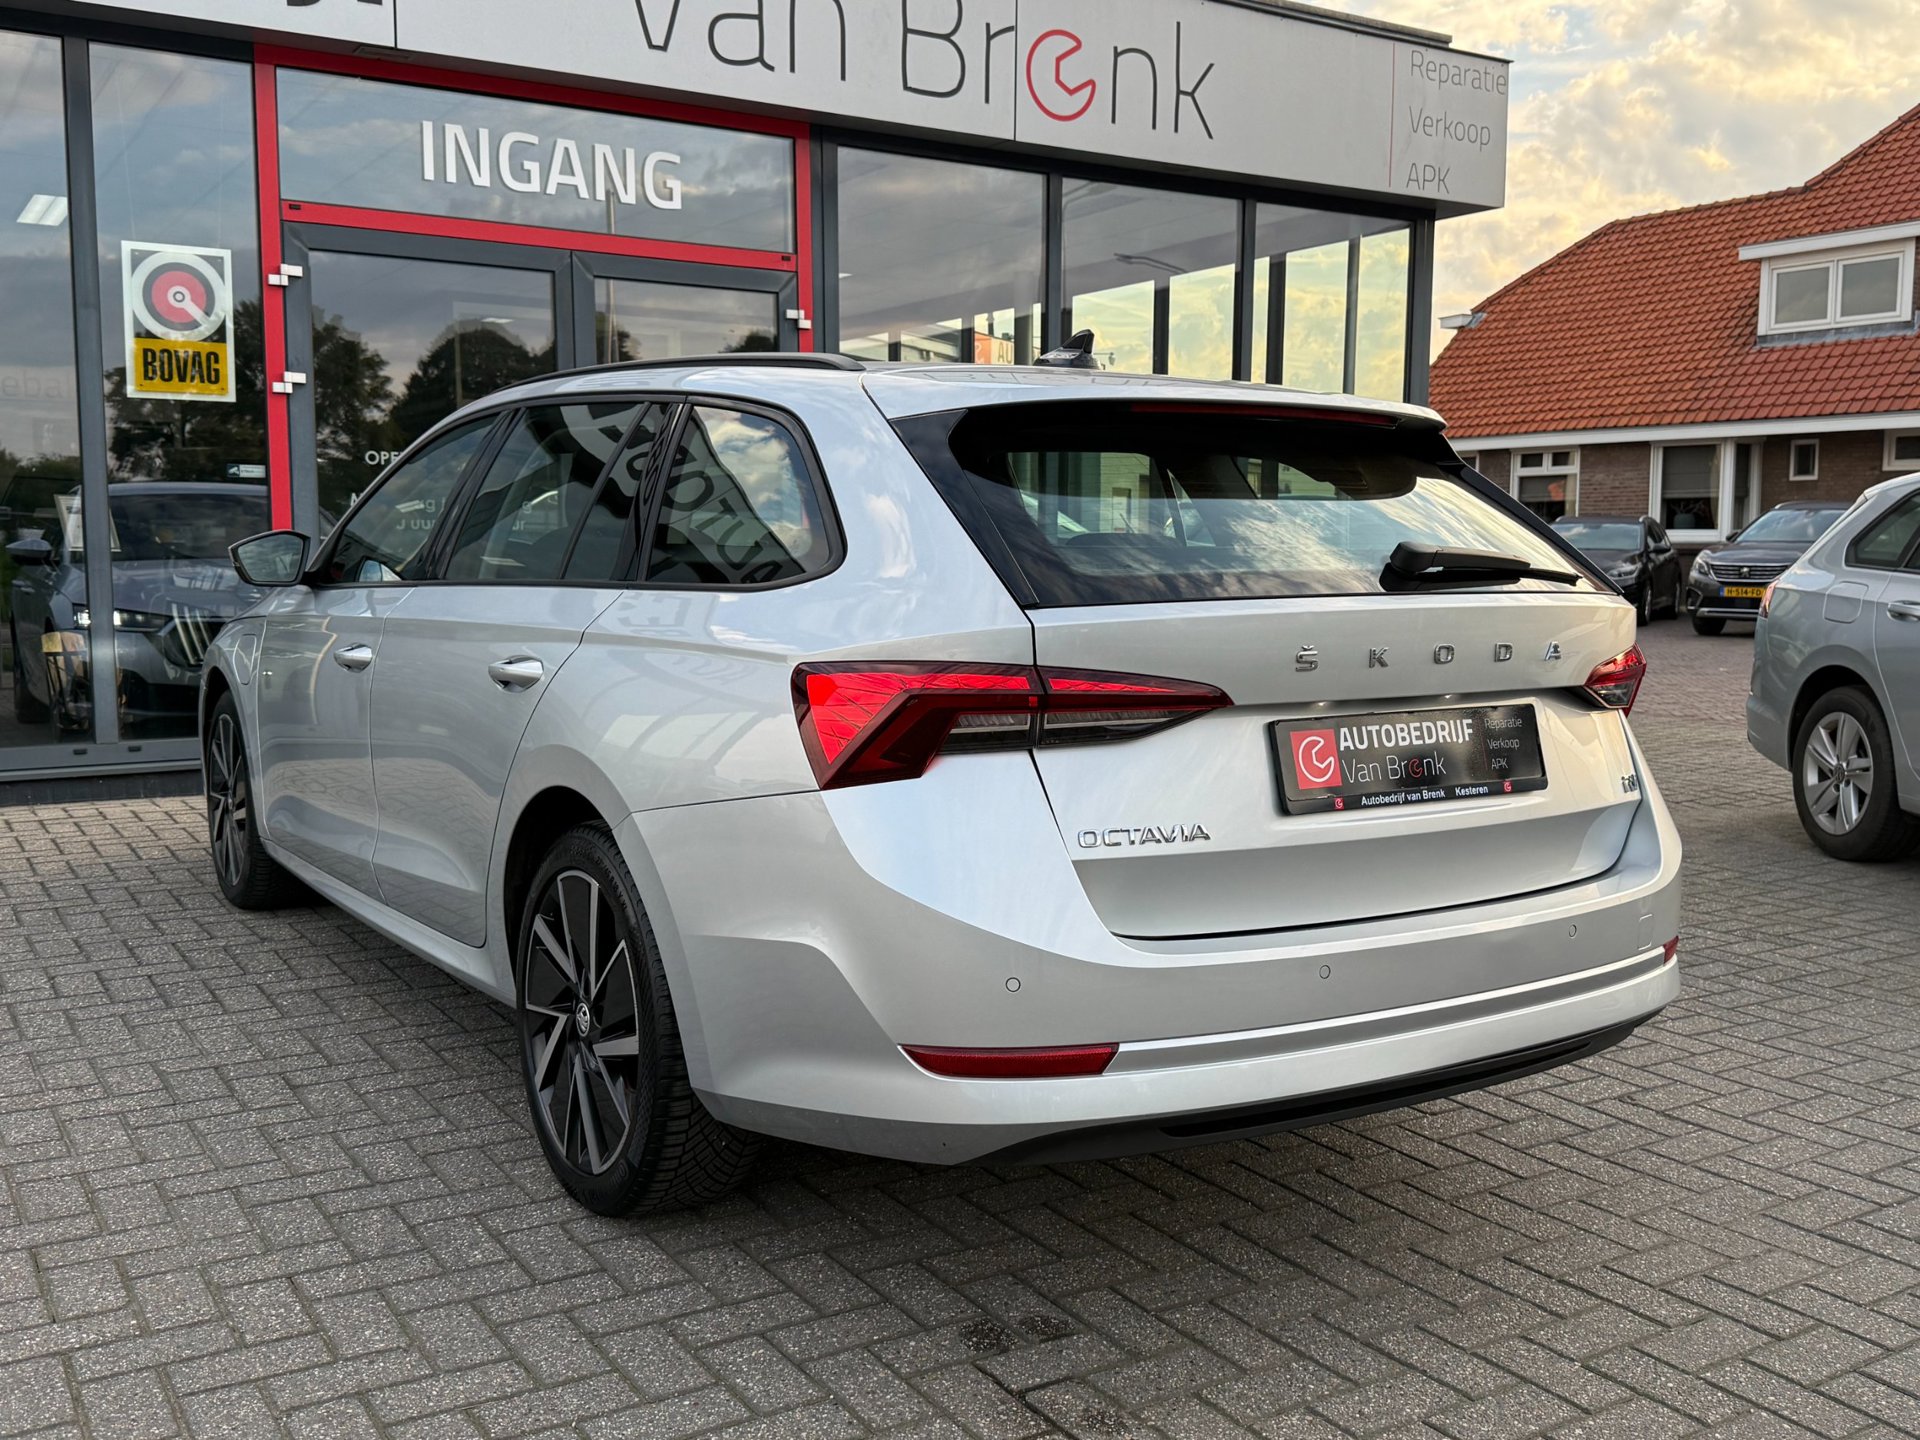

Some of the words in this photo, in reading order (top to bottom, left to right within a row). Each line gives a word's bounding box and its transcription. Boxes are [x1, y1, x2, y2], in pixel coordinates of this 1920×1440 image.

[1410, 50, 1507, 95] Reparatie
[1409, 106, 1491, 152] Verkoop
[422, 120, 682, 209] INGANG
[1406, 162, 1450, 194] APK
[143, 348, 220, 385] BOVAG
[365, 450, 402, 465] OPE
[1295, 641, 1562, 672] ŠKODA
[1340, 719, 1473, 751] AUTOBEDRIJF
[1484, 717, 1523, 731] Reparatie
[1487, 738, 1520, 750] Verkoop
[1342, 758, 1382, 783] Van
[1491, 757, 1509, 770] APK
[1361, 794, 1405, 806] Autobedrijf
[1406, 791, 1421, 801] van
[1422, 788, 1446, 800] Brenk
[1455, 785, 1489, 797] Kesteren
[1078, 823, 1212, 849] OCTAVIA
